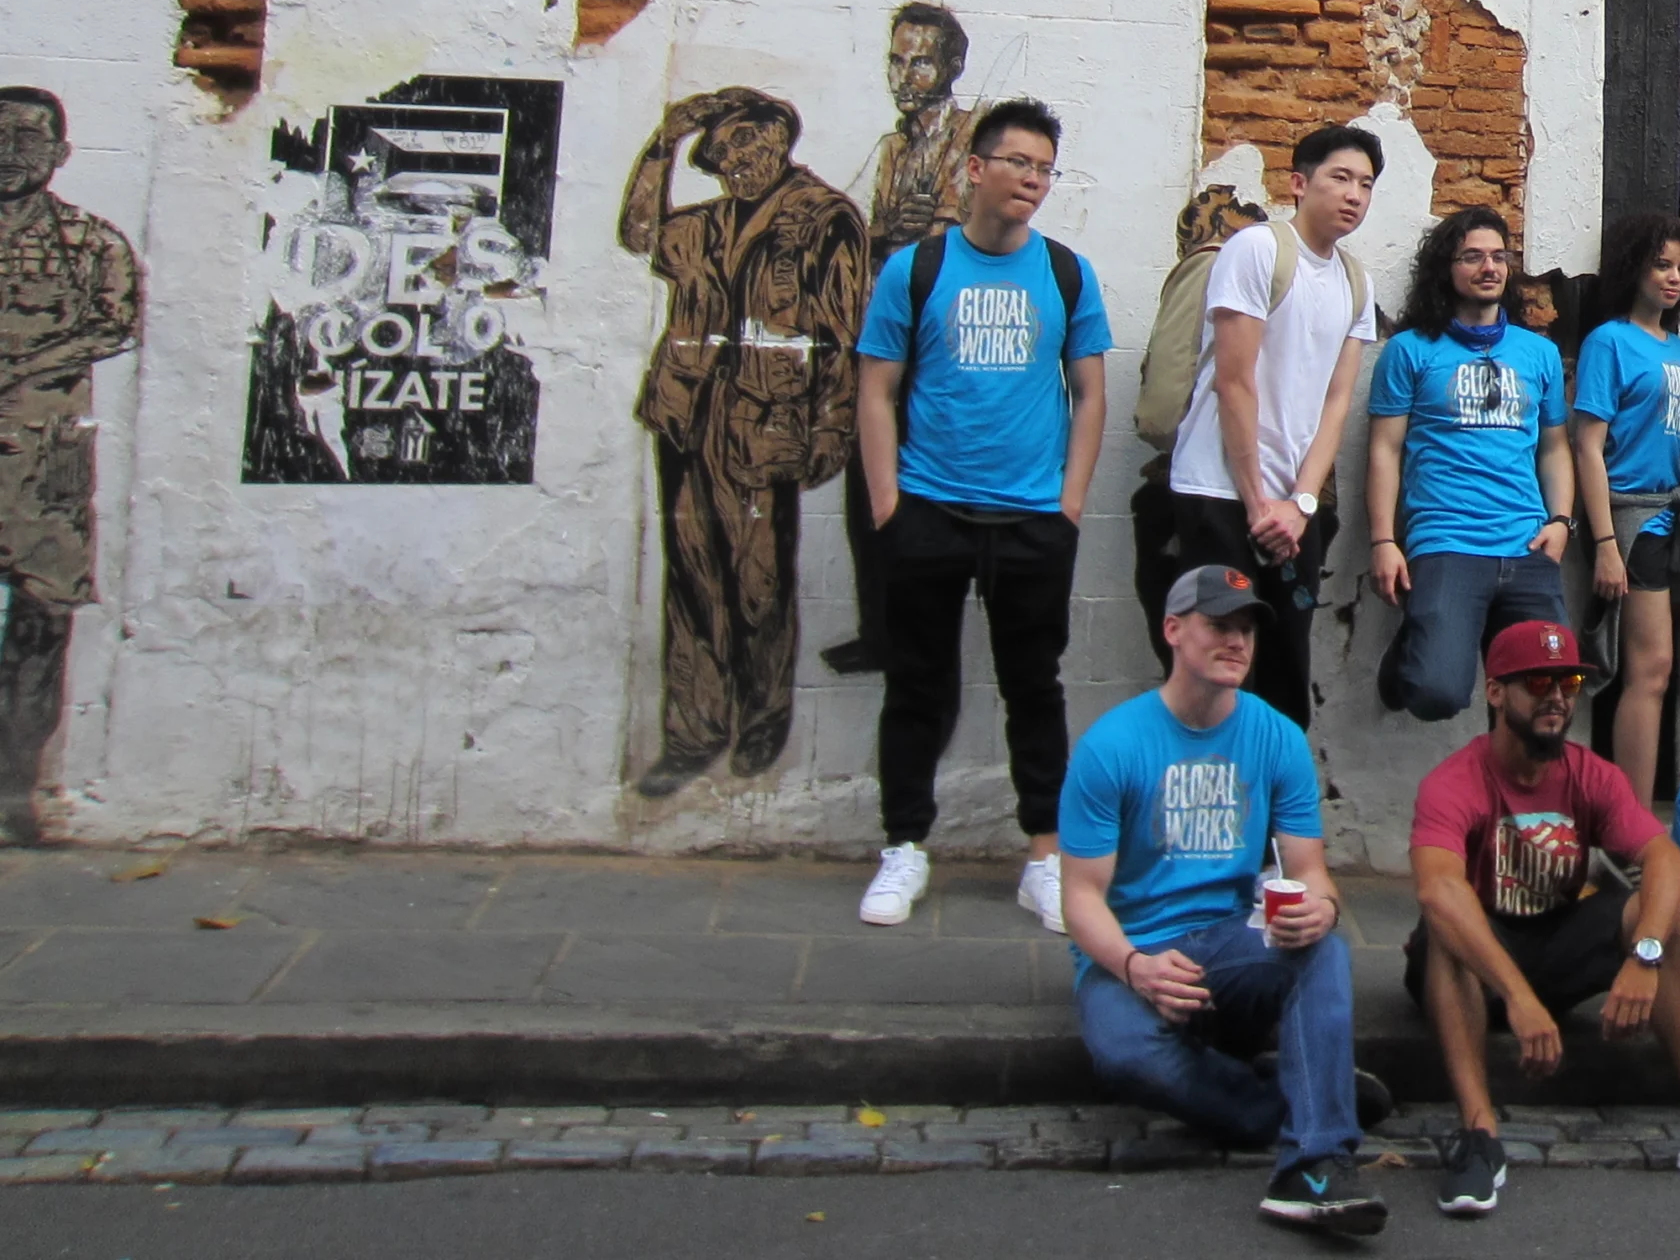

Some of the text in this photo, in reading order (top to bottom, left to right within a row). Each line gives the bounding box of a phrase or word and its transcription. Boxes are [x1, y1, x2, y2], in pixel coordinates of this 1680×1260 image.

[959, 288, 1030, 326] GLOBAL
[959, 326, 1029, 365] WORKS
[1164, 763, 1239, 809] GLOBAL
[1164, 808, 1236, 852] WORKS
